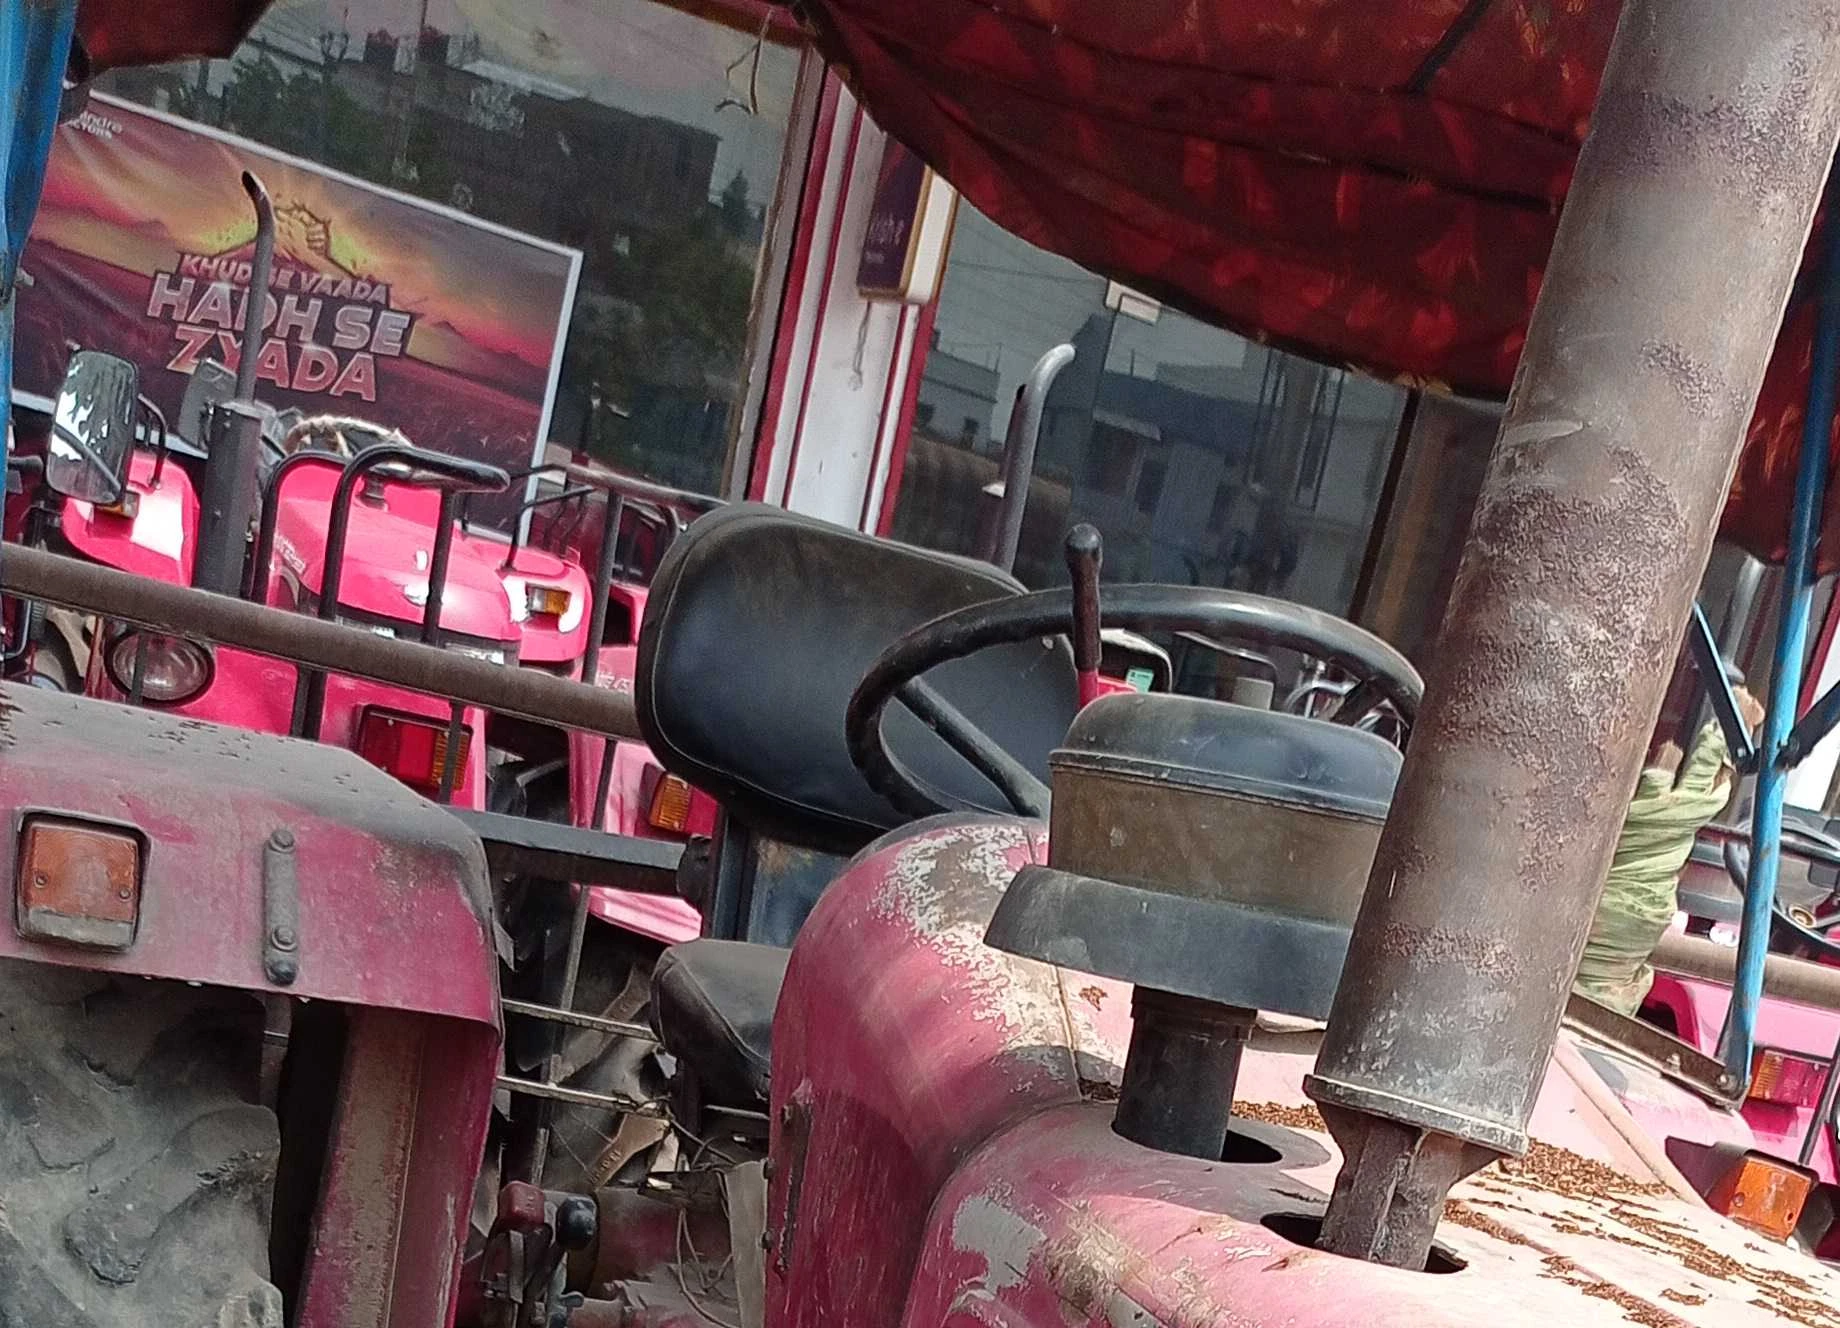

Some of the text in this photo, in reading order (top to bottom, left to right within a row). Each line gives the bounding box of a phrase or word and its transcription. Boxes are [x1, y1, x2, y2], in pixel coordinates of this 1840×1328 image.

[180, 254, 254, 281] KHUD
[299, 270, 389, 305] VAADA
[333, 303, 411, 357] SE
